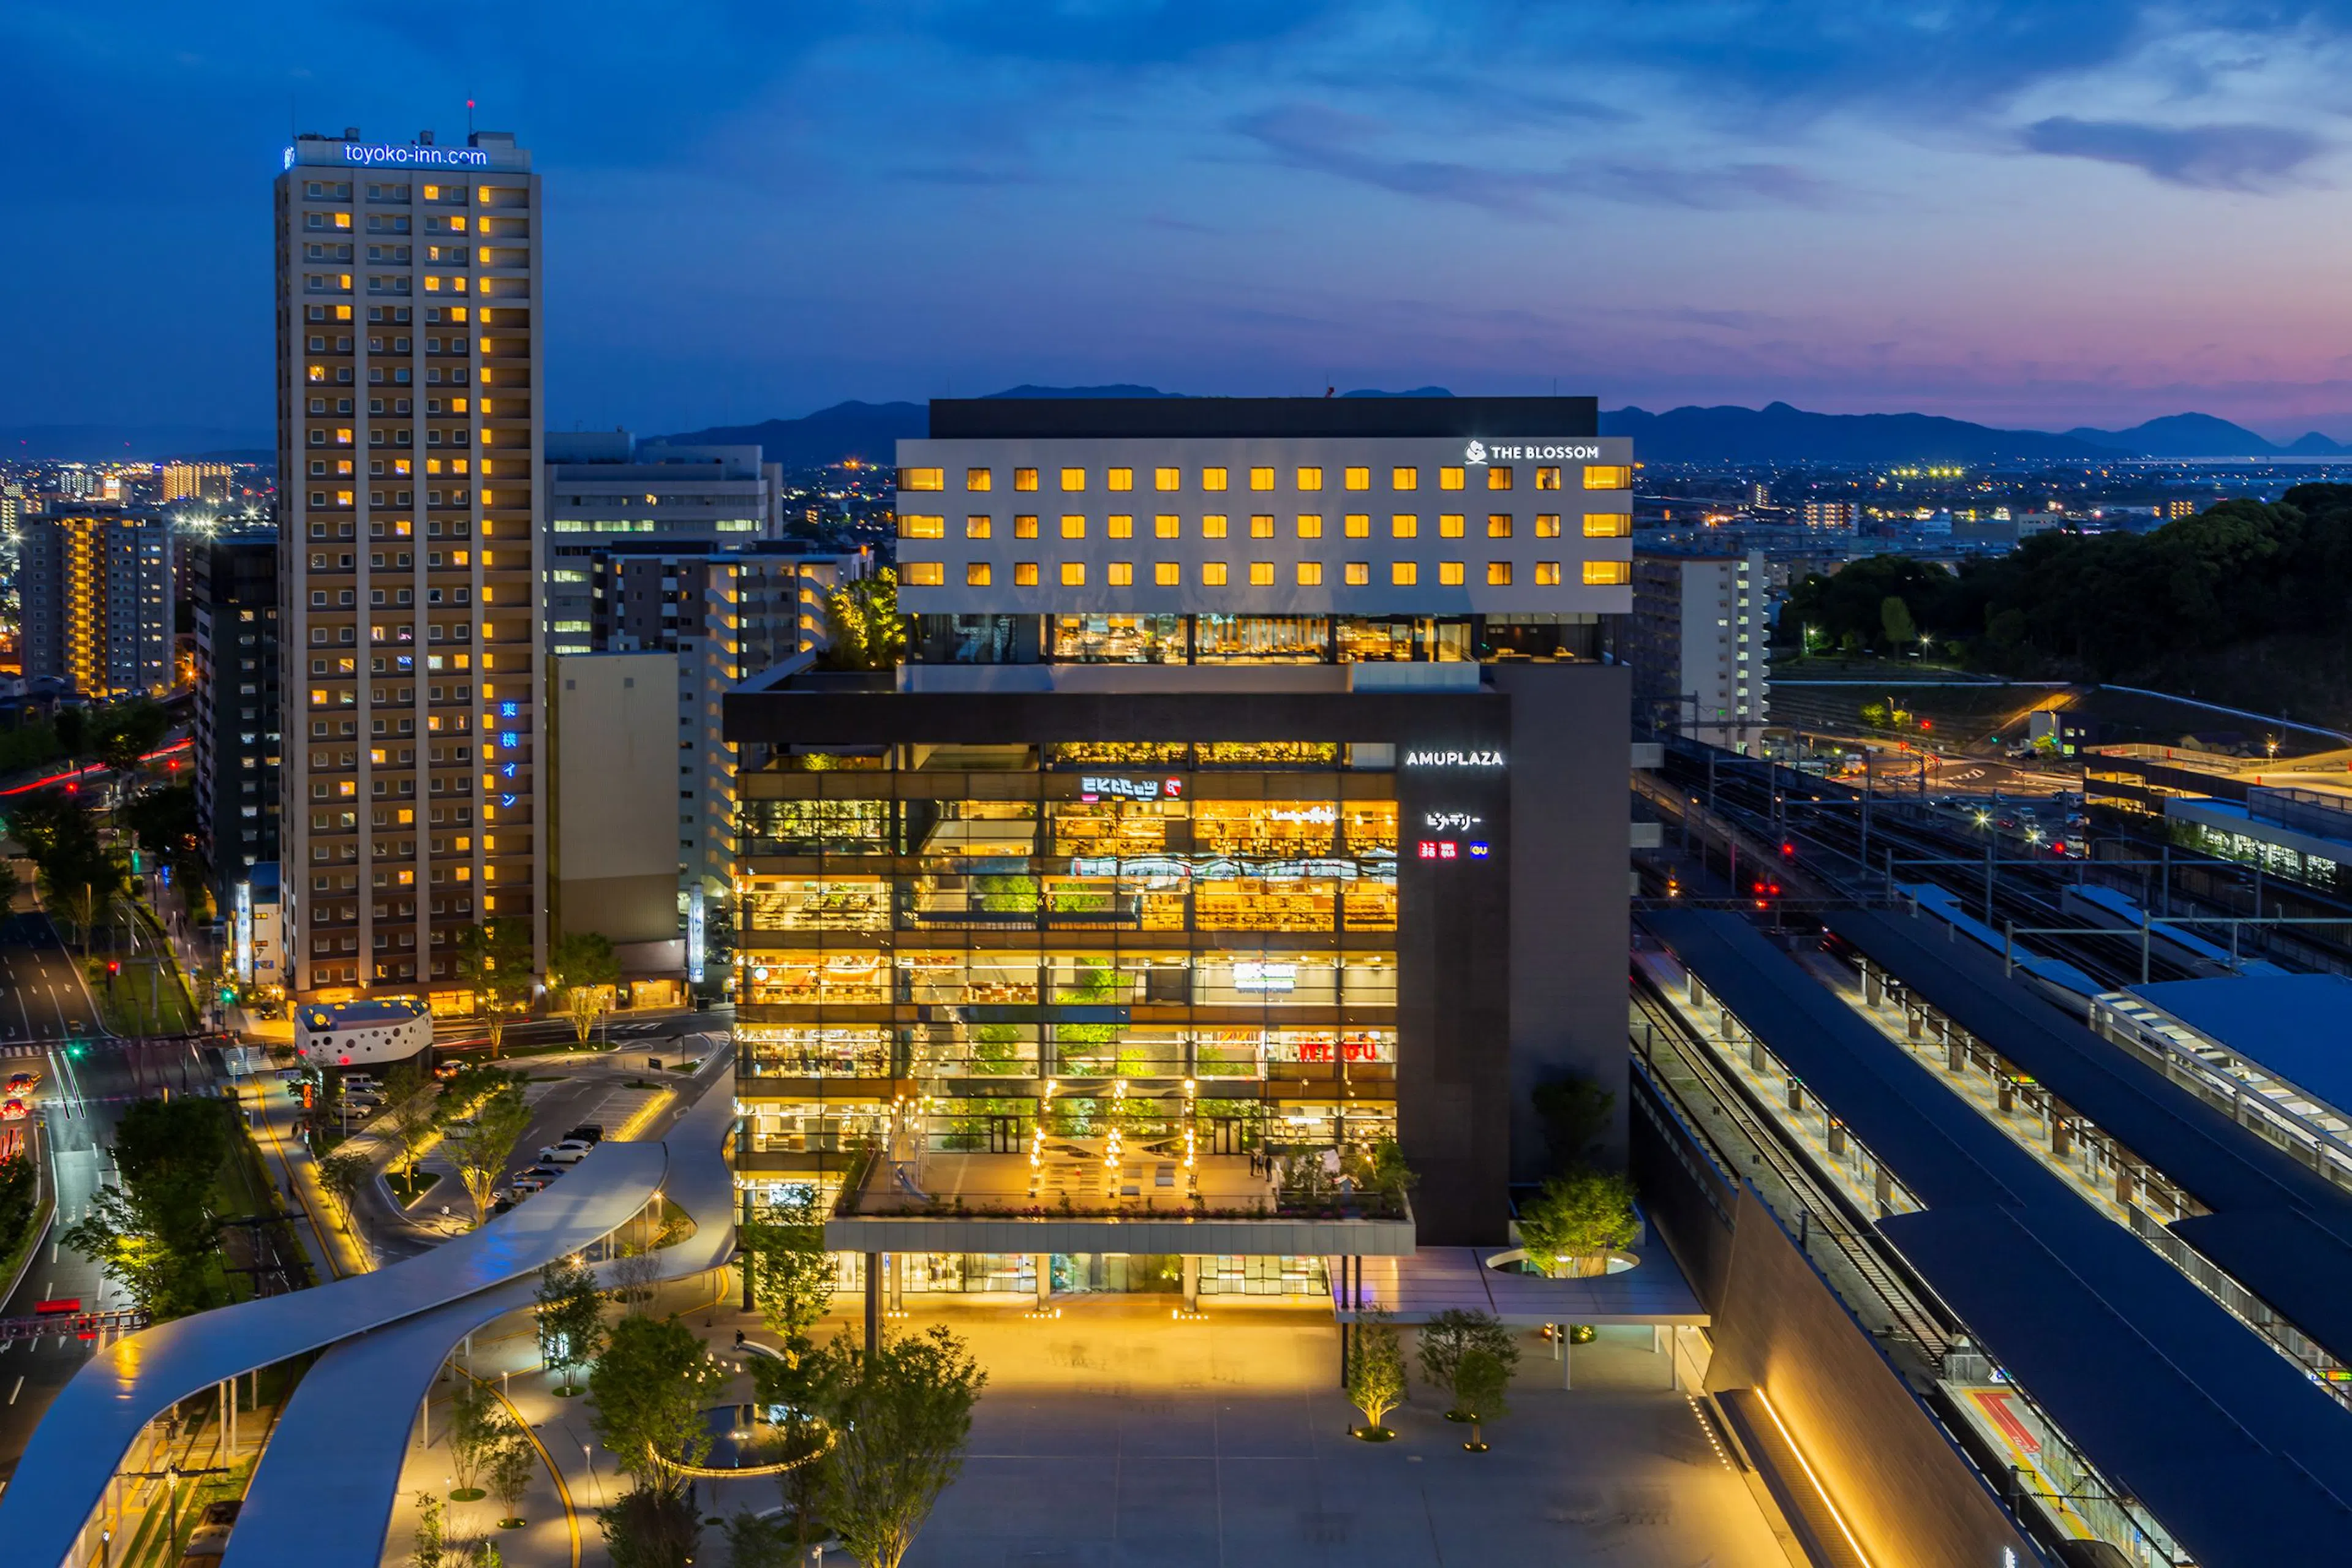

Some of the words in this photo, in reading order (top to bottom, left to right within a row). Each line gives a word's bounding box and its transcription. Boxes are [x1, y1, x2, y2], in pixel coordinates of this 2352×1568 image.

[345, 144, 488, 165] toyoko-inn.com
[1491, 447, 1521, 459] THE
[1526, 447, 1599, 459] BLOSSOM
[1406, 751, 1504, 766] AMUPLAZA
[1426, 812, 1482, 831] ピカデリー
